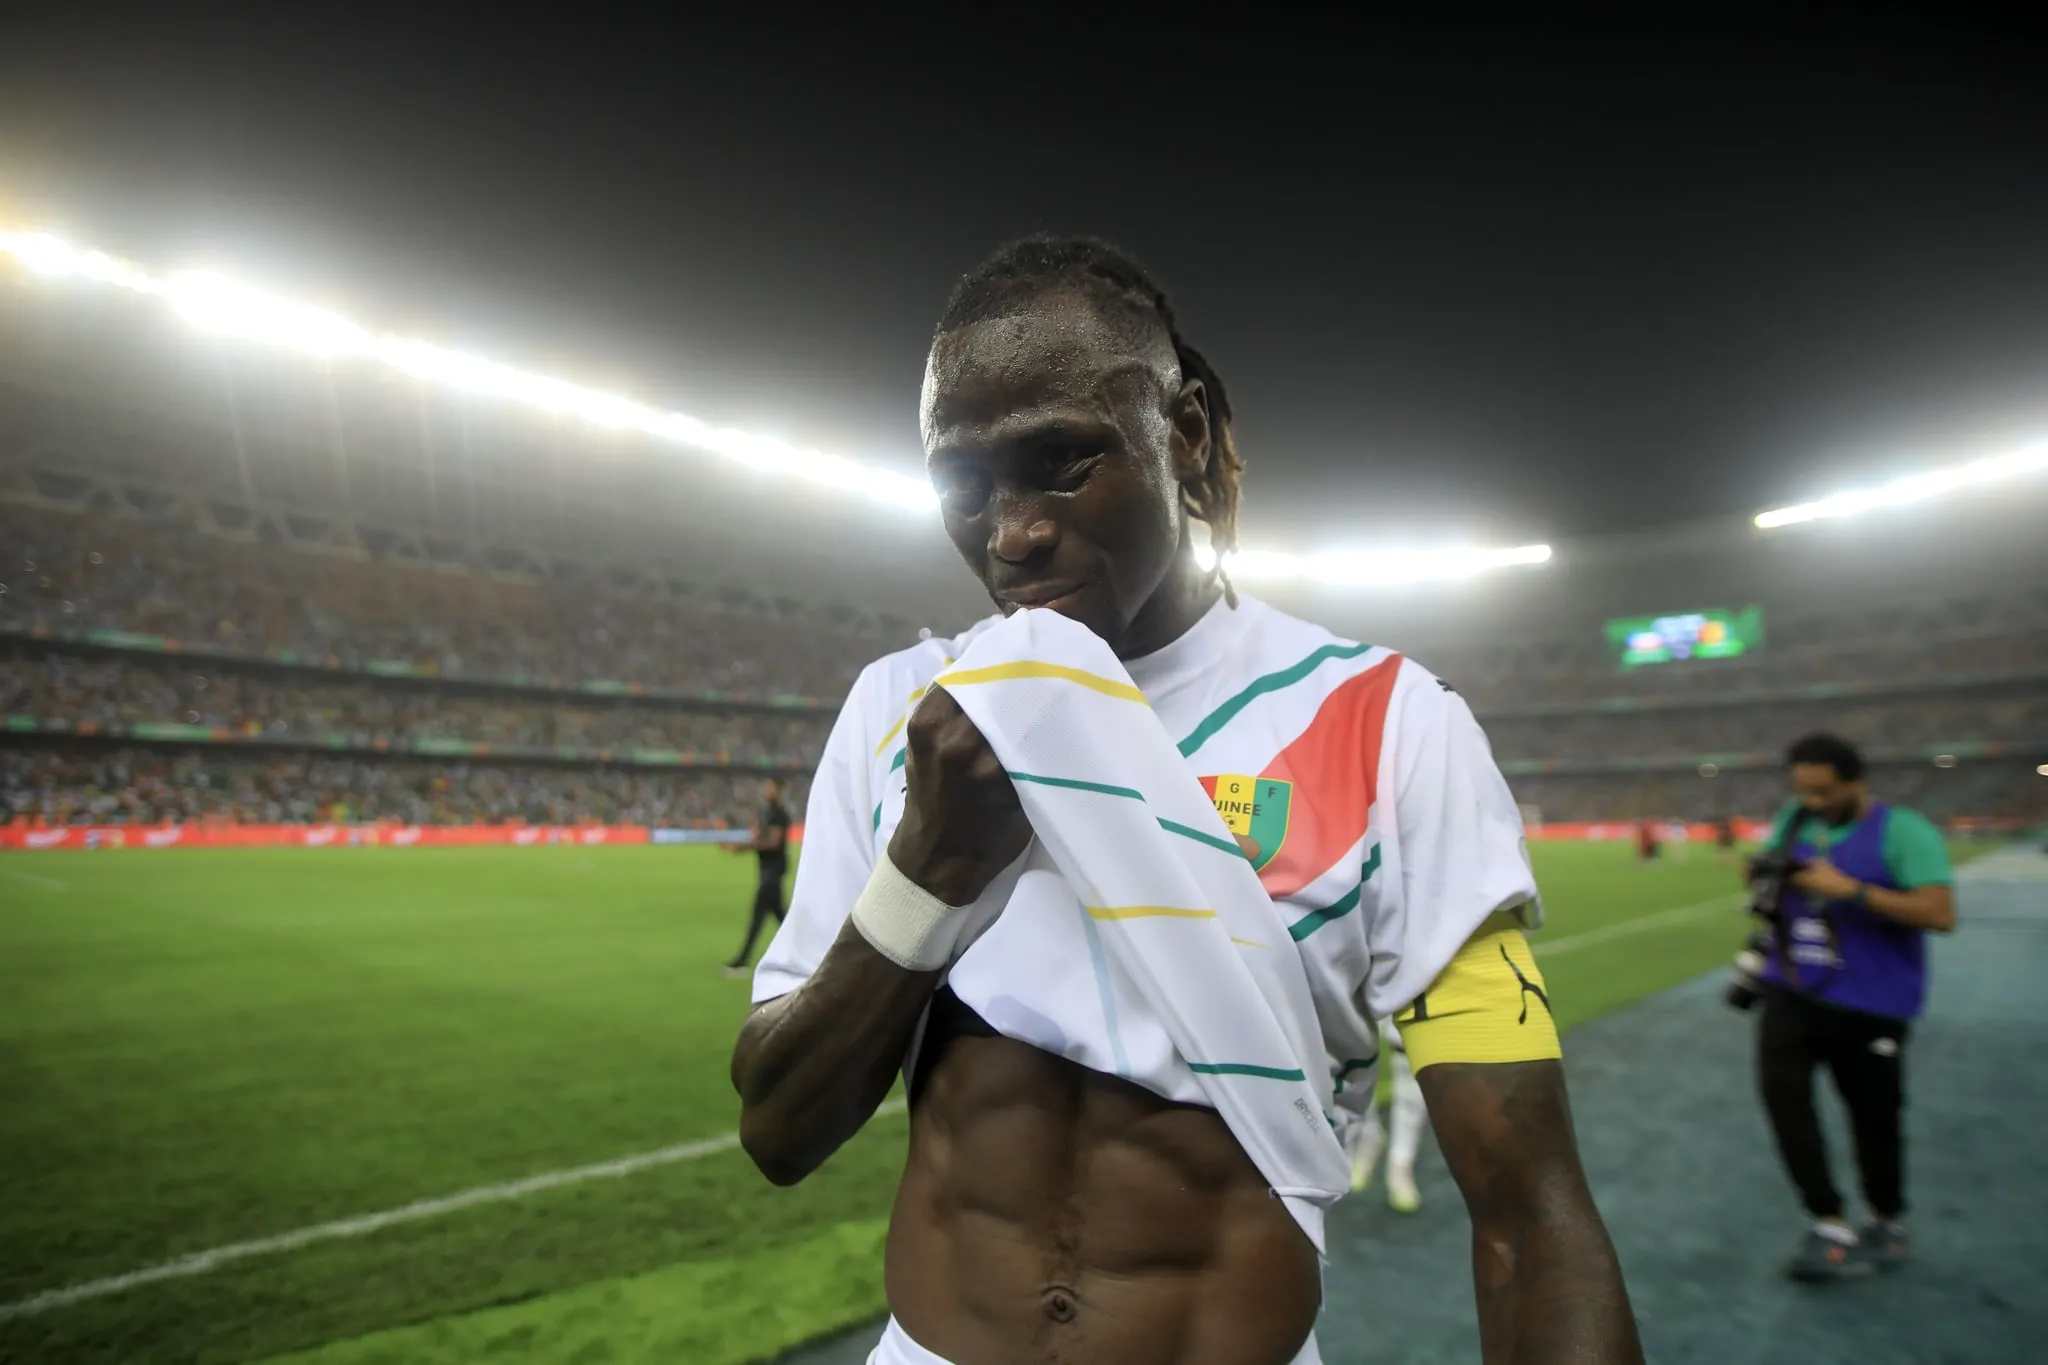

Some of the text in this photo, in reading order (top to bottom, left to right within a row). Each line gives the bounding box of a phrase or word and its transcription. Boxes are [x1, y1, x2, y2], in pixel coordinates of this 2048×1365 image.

[1230, 783, 1278, 798] G F
[1213, 800, 1262, 816] UINEE
